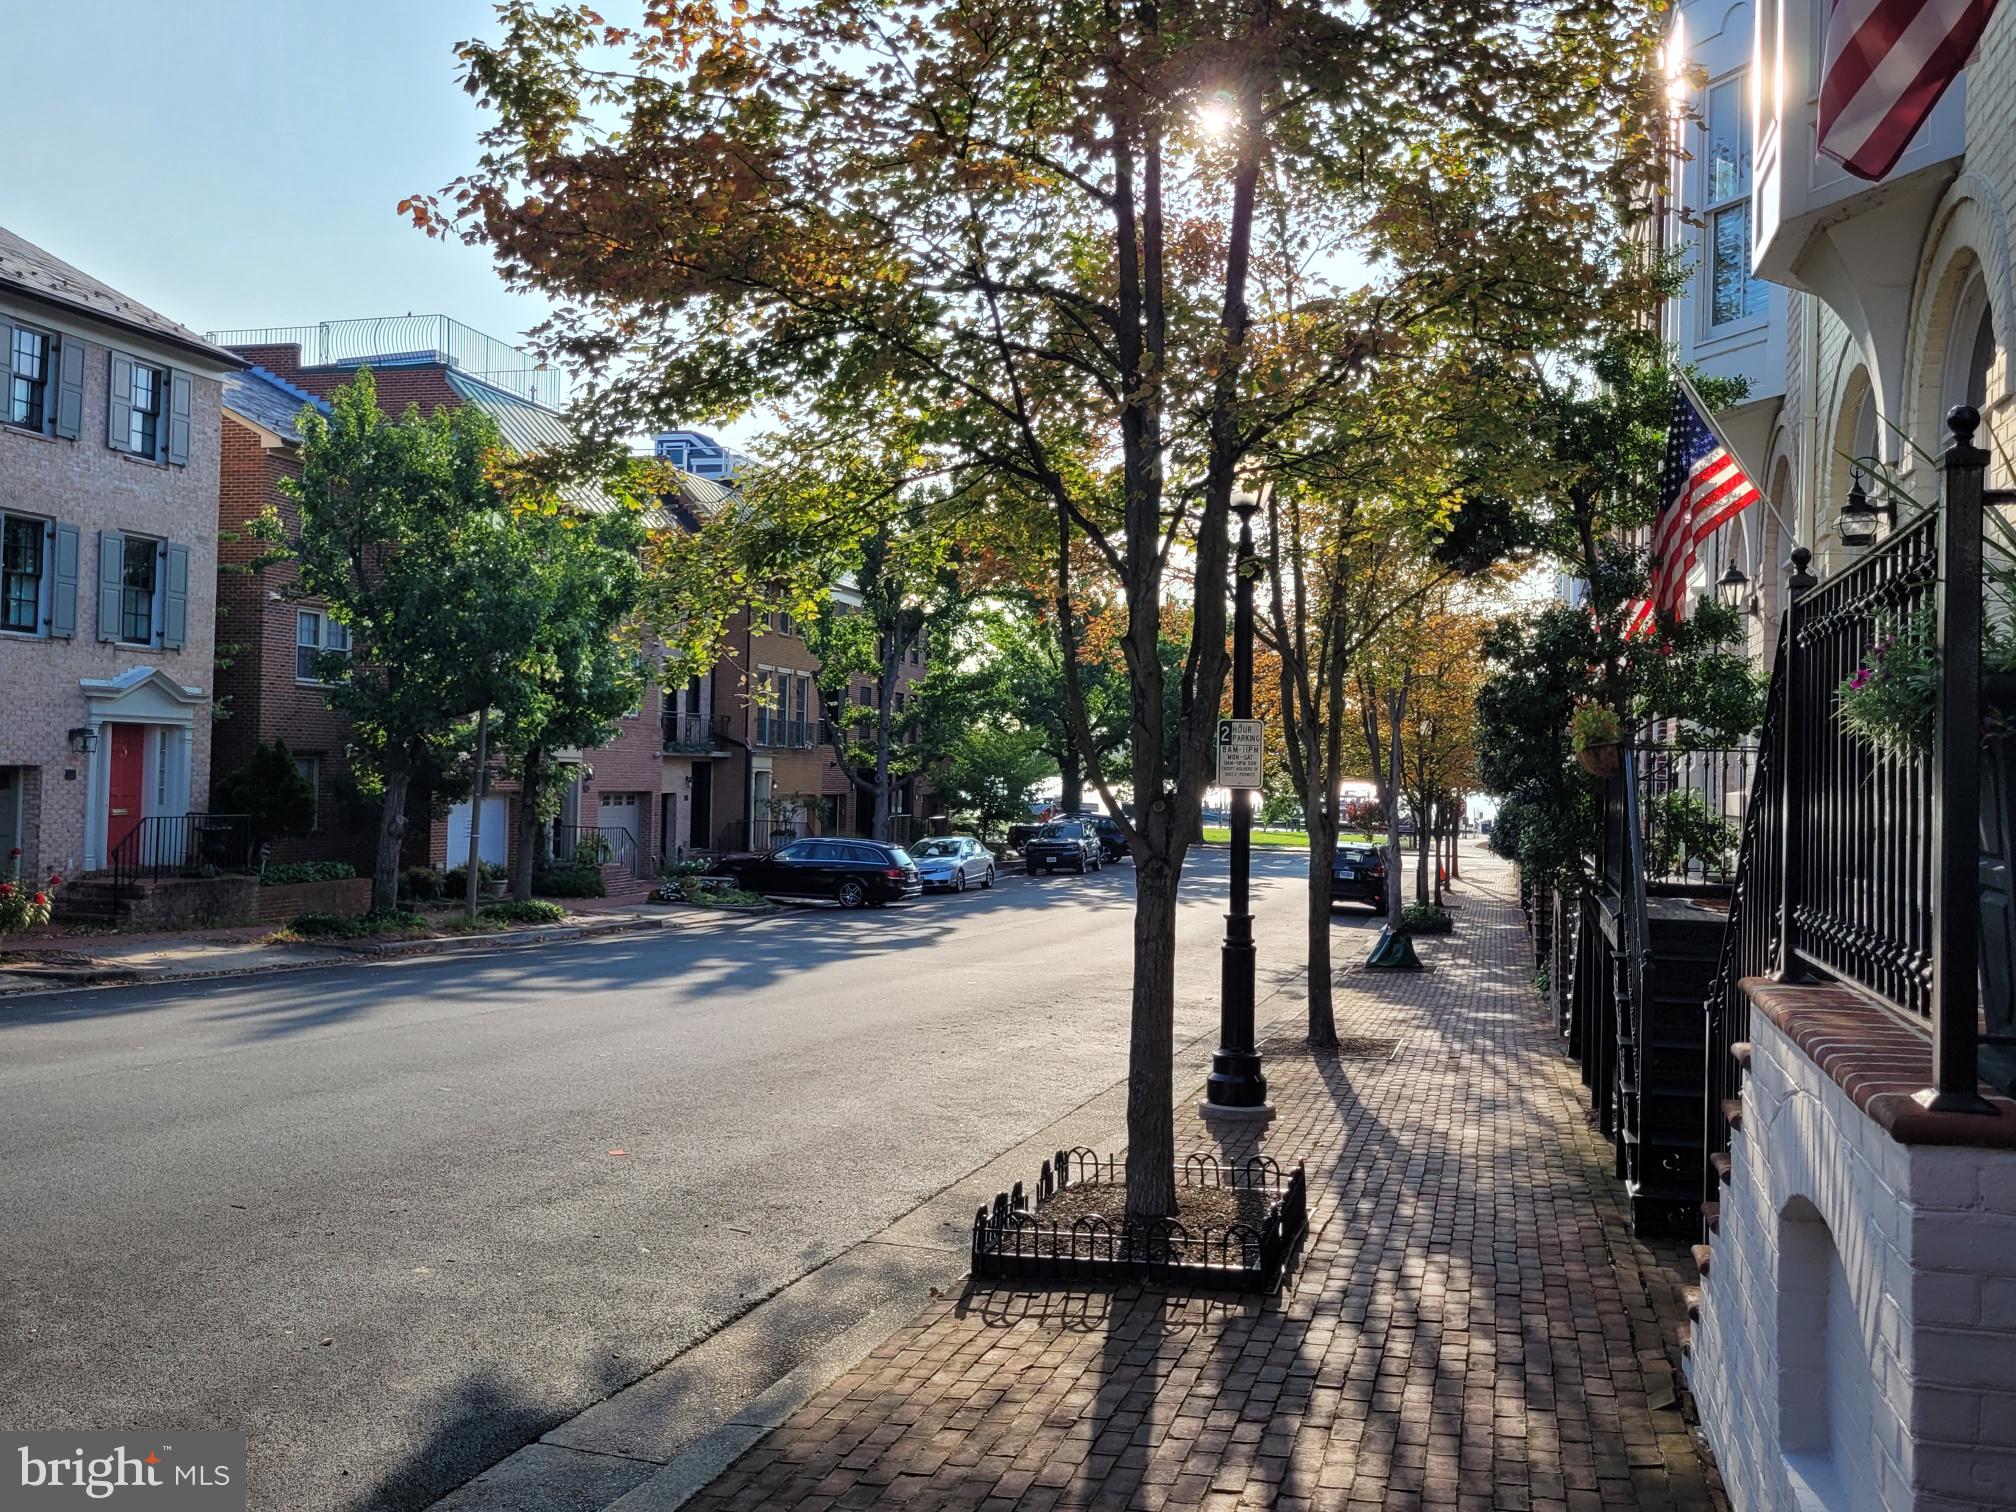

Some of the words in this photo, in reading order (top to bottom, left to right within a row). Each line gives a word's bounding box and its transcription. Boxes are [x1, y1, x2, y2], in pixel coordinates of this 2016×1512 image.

[1221, 726, 1230, 742] 2
[1232, 726, 1252, 734] HOUR
[1232, 734, 1260, 742] PARKING
